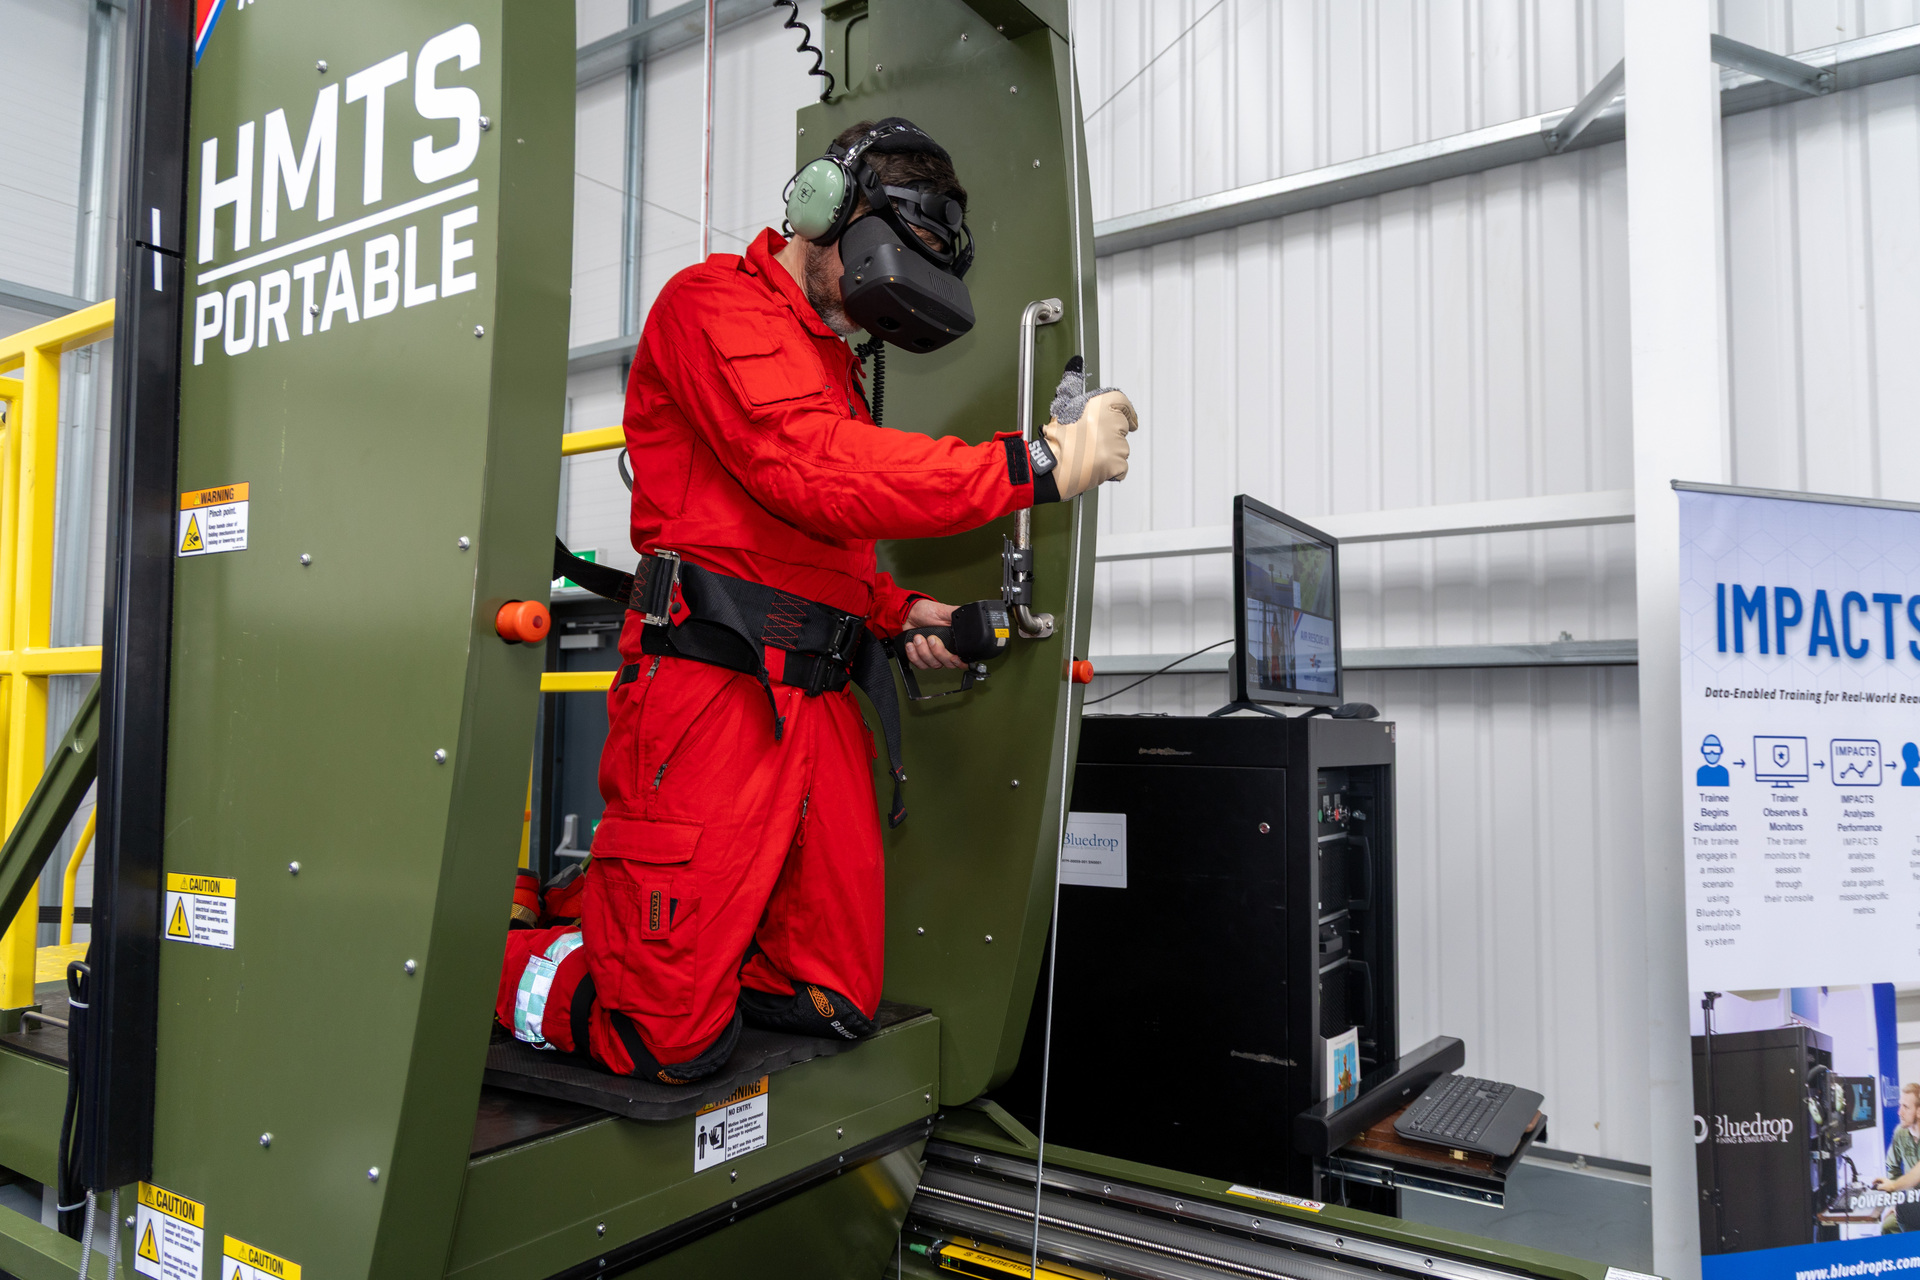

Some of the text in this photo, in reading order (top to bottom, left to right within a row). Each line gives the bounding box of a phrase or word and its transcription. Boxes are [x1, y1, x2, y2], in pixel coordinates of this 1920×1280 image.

[199, 23, 481, 264] HMTS
[194, 205, 478, 365] PORTABLE
[200, 488, 234, 504] WARNING
[1705, 686, 1777, 700] Data-Enabled
[1779, 688, 1822, 704] Training
[1823, 690, 1839, 704] for
[1841, 691, 1896, 703] Real-World
[1836, 746, 1876, 756] IMPACTS
[1699, 793, 1729, 802] Trainee
[1771, 793, 1799, 802] Trainer
[1841, 795, 1874, 804] IMPACTS
[1701, 808, 1729, 819] Begins
[1763, 808, 1808, 817] Observes &
[1843, 809, 1875, 819] Analyzes
[1694, 822, 1737, 831] Simulation
[1769, 822, 1803, 831] Monitors
[1837, 823, 1882, 832] Performance
[1064, 832, 1118, 852] Bluedrop
[1692, 837, 1739, 845] The trainee
[1766, 837, 1781, 845] The
[1843, 837, 1878, 846] IMPACTS
[1696, 852, 1728, 862] engages
[190, 878, 220, 893] CAUTION
[736, 1102, 752, 1114] ENTRY.
[156, 1190, 195, 1221] CAUTION
[1850, 1191, 1905, 1210] POWERED
[248, 1249, 283, 1275] CAUTION
[1796, 1256, 1920, 1280] www.bluedropts.com
